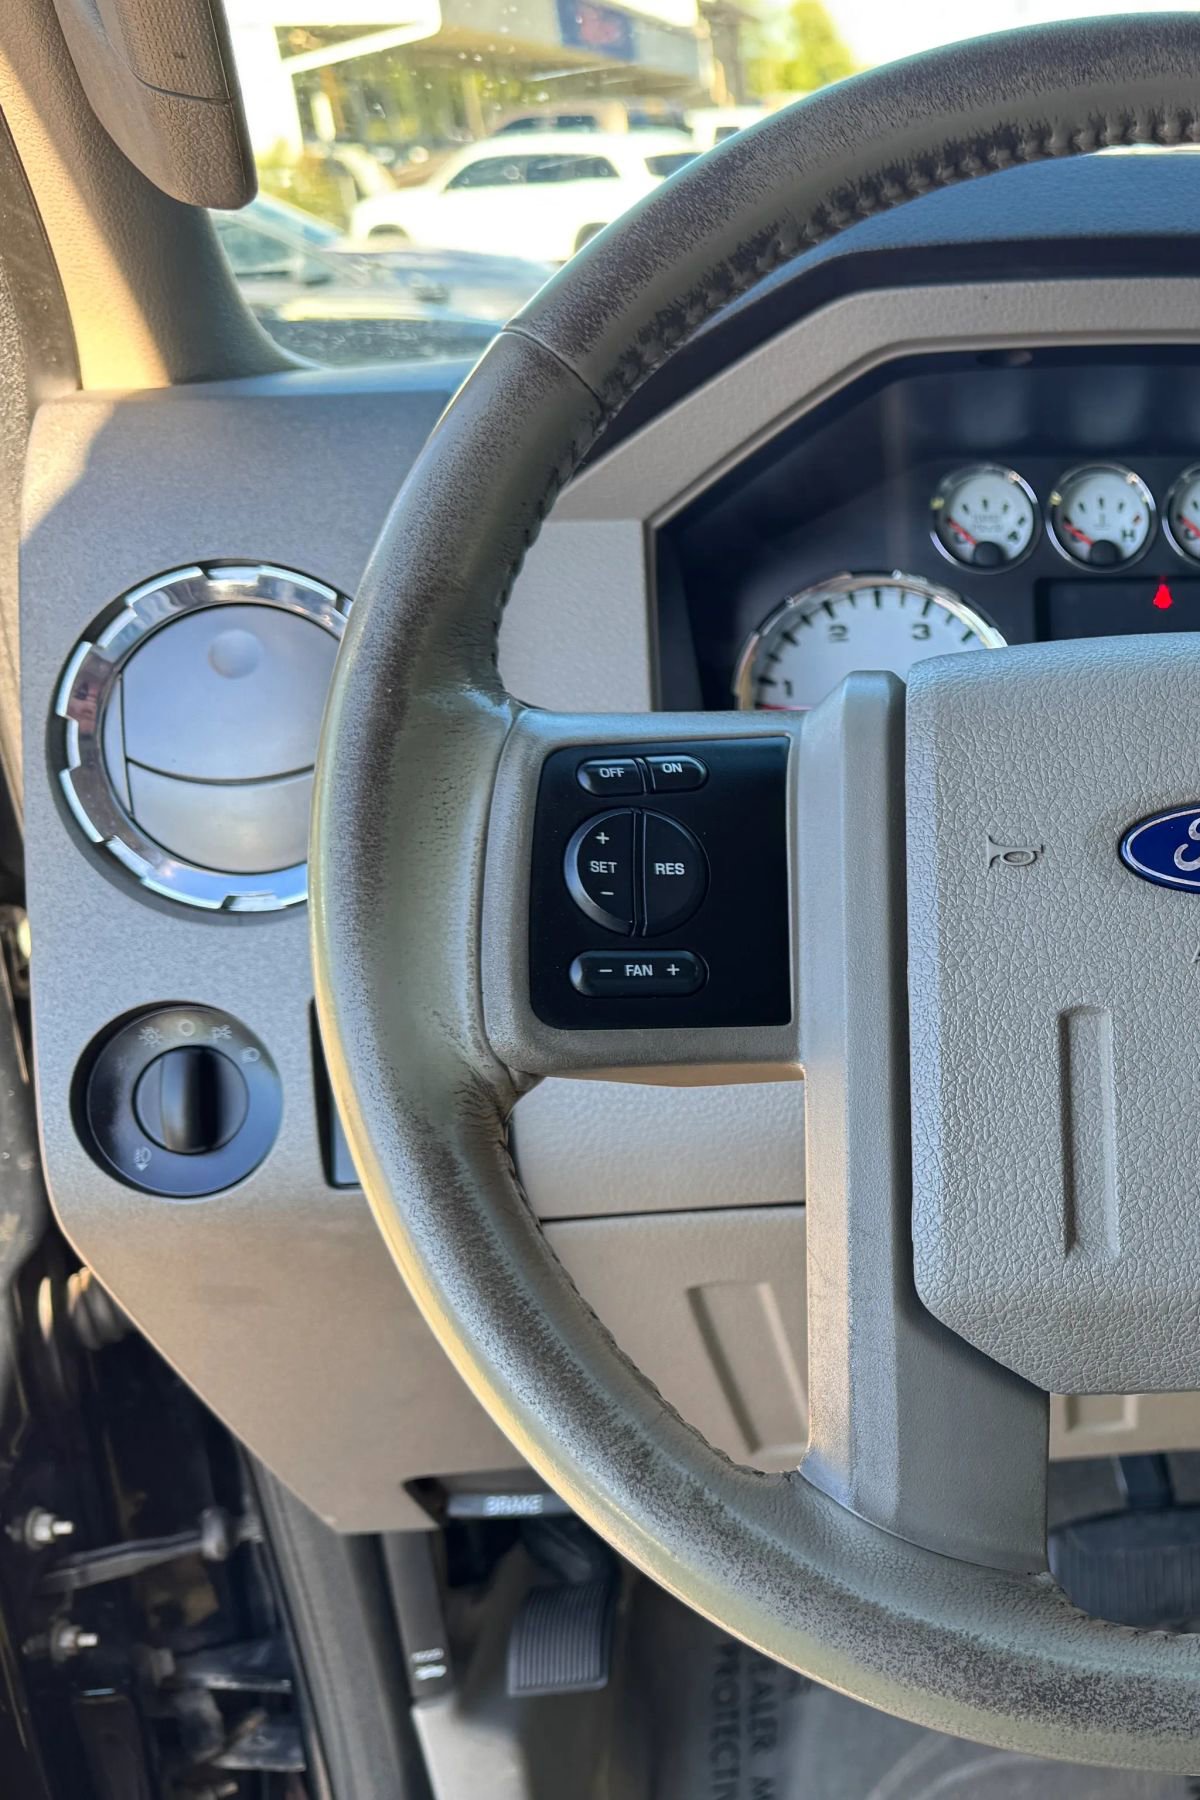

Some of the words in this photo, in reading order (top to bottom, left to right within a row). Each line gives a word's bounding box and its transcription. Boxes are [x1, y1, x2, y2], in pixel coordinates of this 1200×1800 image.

[828, 624, 849, 642] 2
[911, 624, 931, 640] 3
[783, 680, 793, 697] 1
[600, 768, 624, 779] OFF
[662, 763, 682, 774] ON
[590, 861, 617, 874] SET
[655, 862, 685, 875] RES
[625, 964, 653, 977] FAN
[485, 1495, 544, 1516] BRAKE
